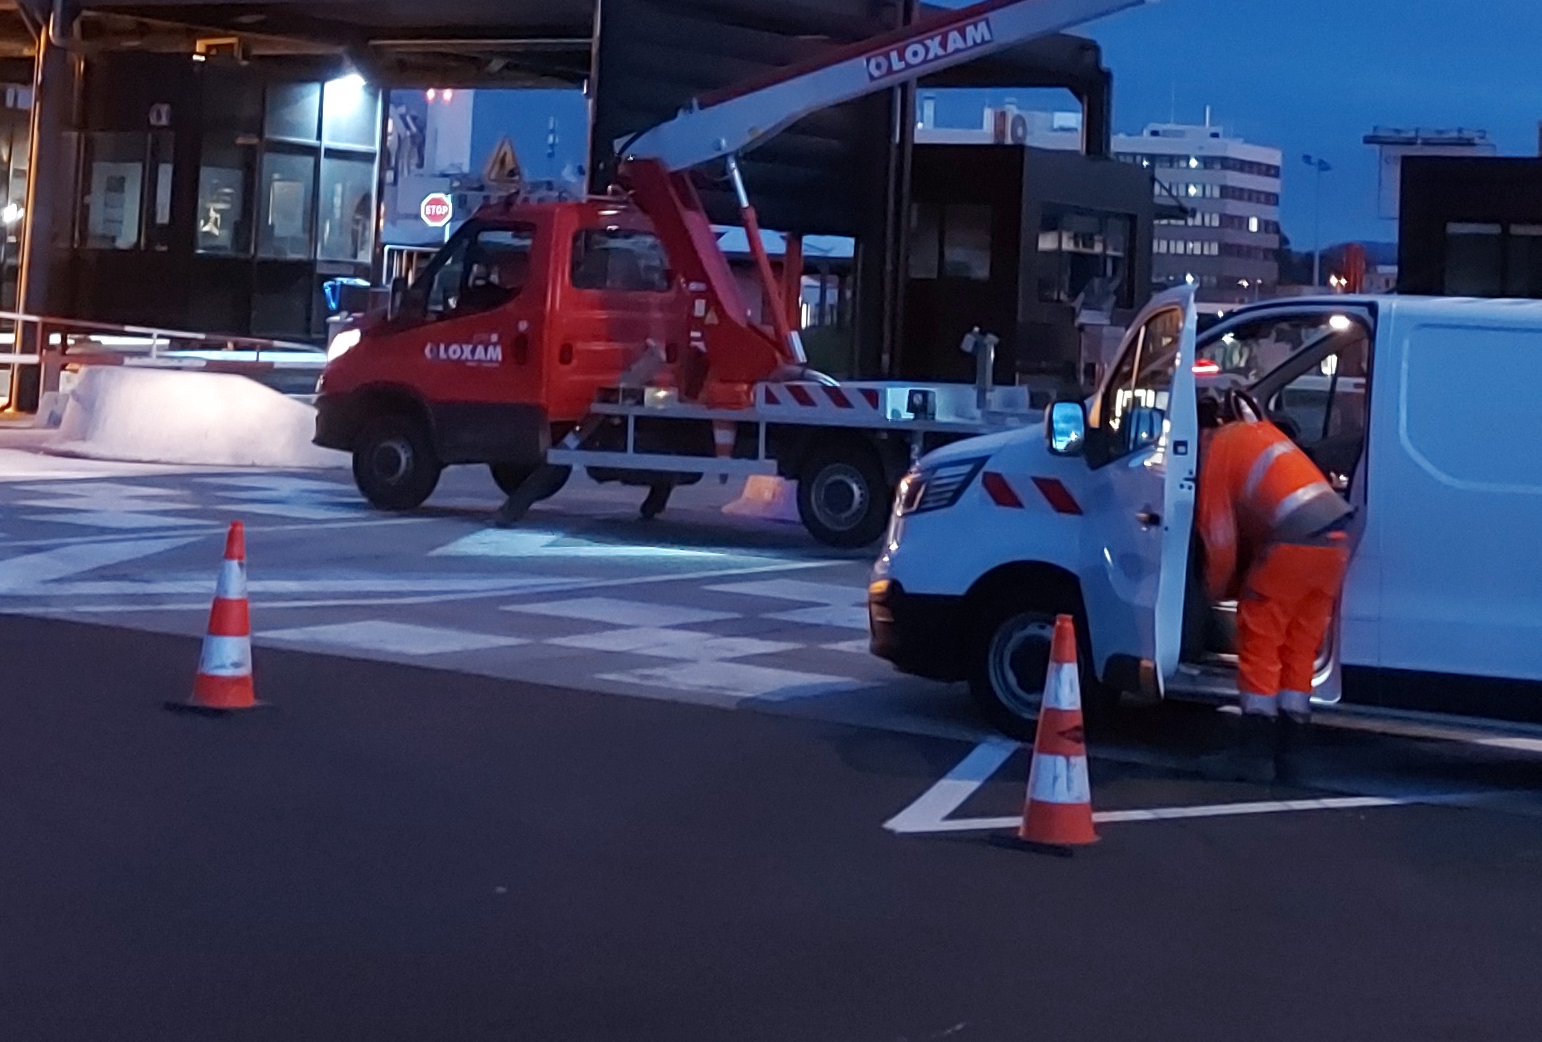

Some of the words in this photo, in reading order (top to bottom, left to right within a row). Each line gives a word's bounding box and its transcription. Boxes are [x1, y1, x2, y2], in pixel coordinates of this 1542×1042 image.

[889, 20, 993, 72] LOXAM
[425, 204, 449, 215] STOP
[439, 342, 502, 361] LOXAM
